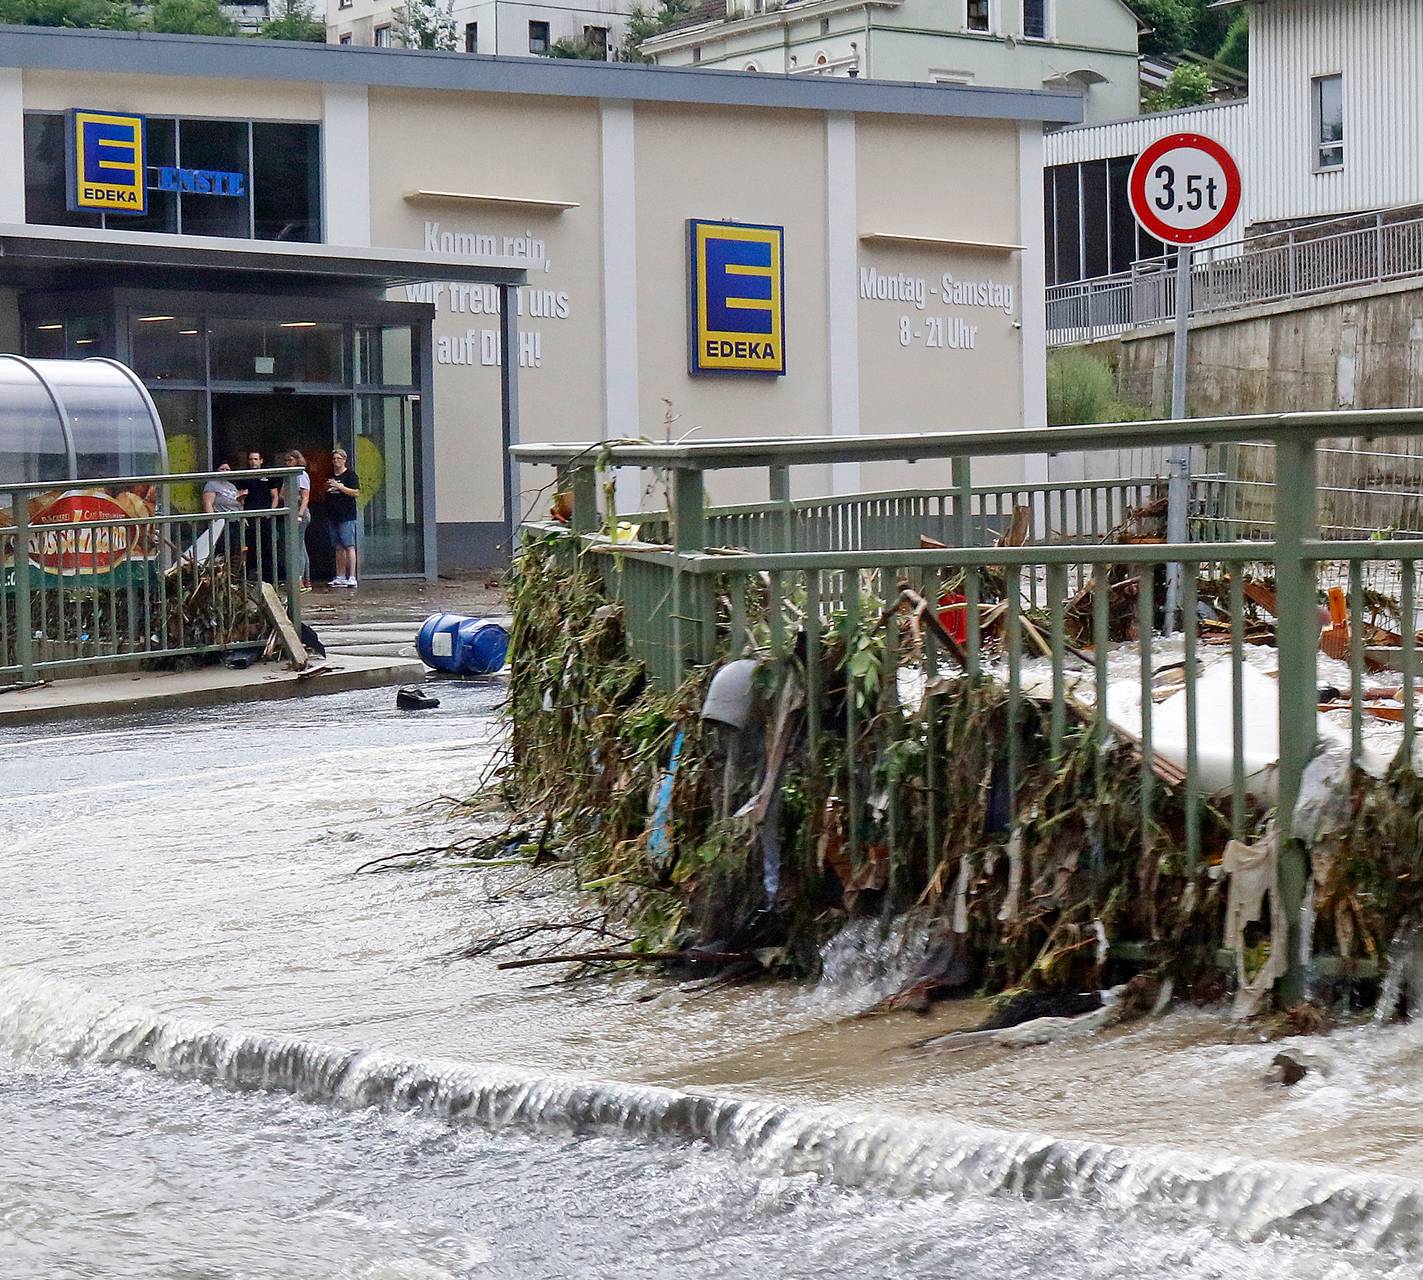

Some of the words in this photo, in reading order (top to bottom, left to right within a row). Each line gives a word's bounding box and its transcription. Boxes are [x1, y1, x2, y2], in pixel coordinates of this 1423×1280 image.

[83, 121, 136, 187] E
[84, 188, 138, 203] EDEKA
[1155, 165, 1217, 213] 3,5t
[424, 221, 497, 257] Komm
[502, 230, 551, 273] rein,
[448, 283, 523, 316] freun
[529, 289, 571, 319] uns
[705, 237, 772, 334] E
[859, 267, 926, 310] Montag
[941, 272, 1014, 315] Samstag
[437, 329, 476, 366] auf
[480, 329, 542, 368] DIH!
[706, 340, 776, 360] EDEKA
[900, 315, 912, 347] 8
[925, 316, 943, 348] 21
[947, 317, 979, 350] Uhr
